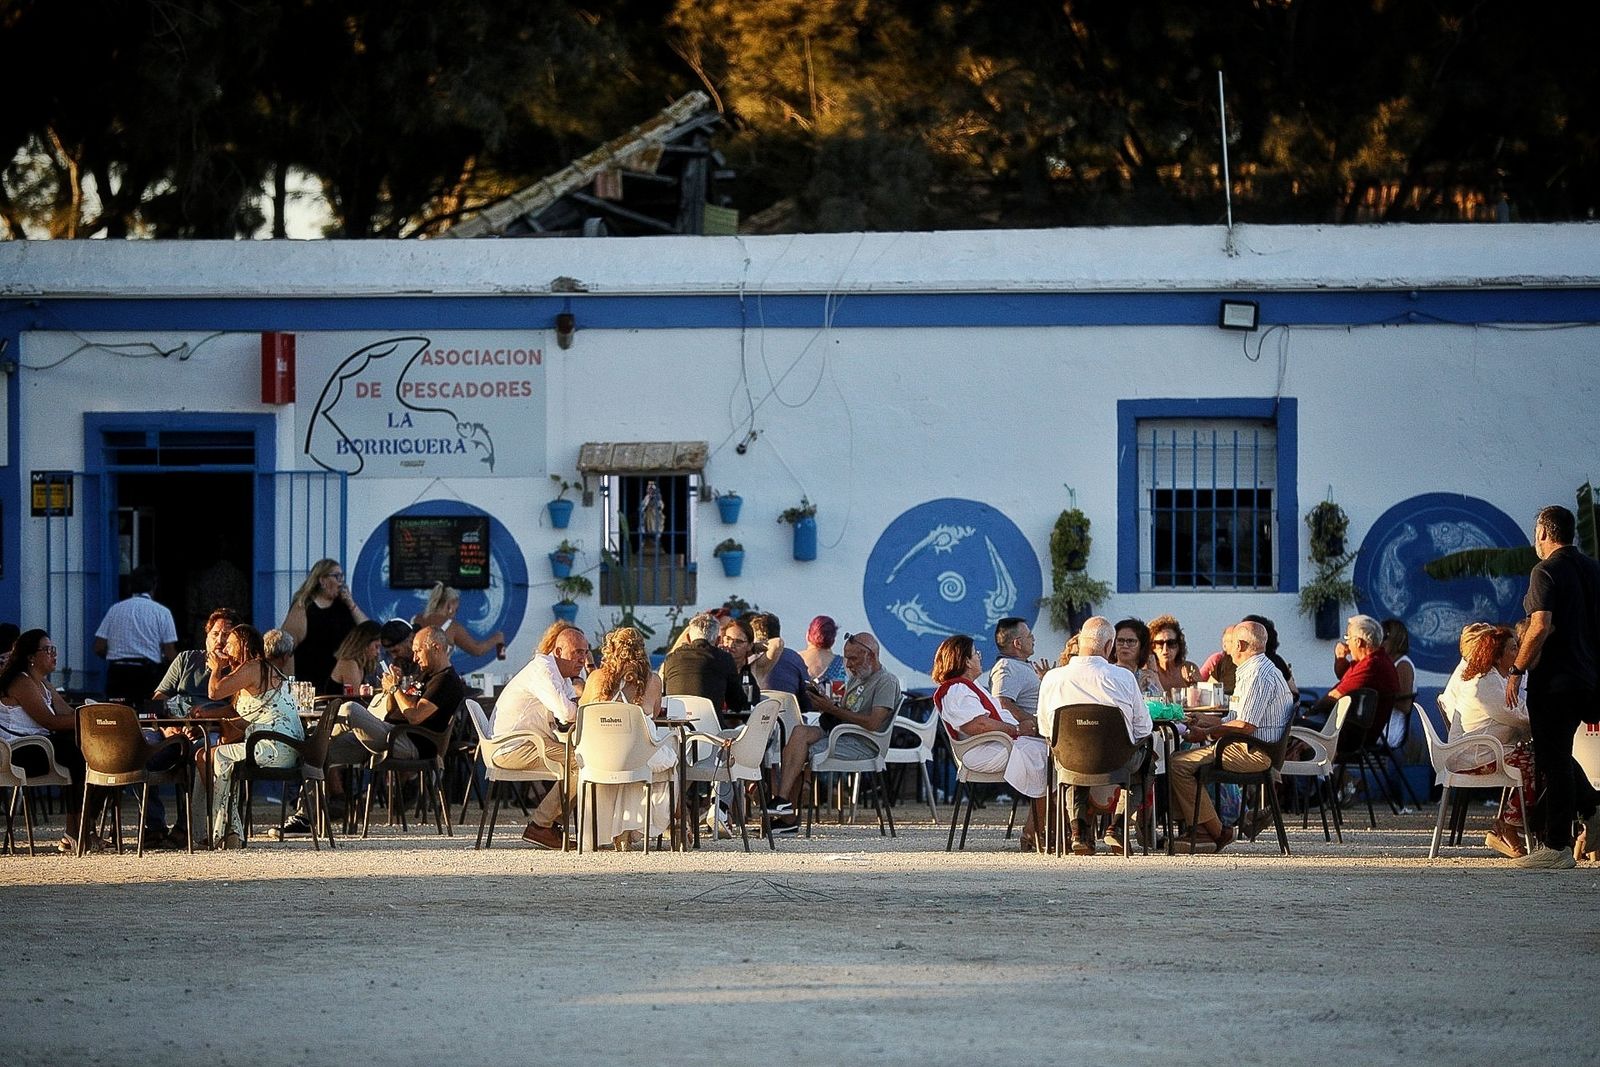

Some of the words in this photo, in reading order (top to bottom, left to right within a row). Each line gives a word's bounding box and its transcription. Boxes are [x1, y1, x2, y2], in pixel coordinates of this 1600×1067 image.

[420, 350, 542, 366] ASOCIACION
[355, 382, 382, 398] DE
[402, 381, 532, 398] PESCADORES
[387, 412, 413, 428] LA
[336, 438, 468, 455] BORRIQUERA
